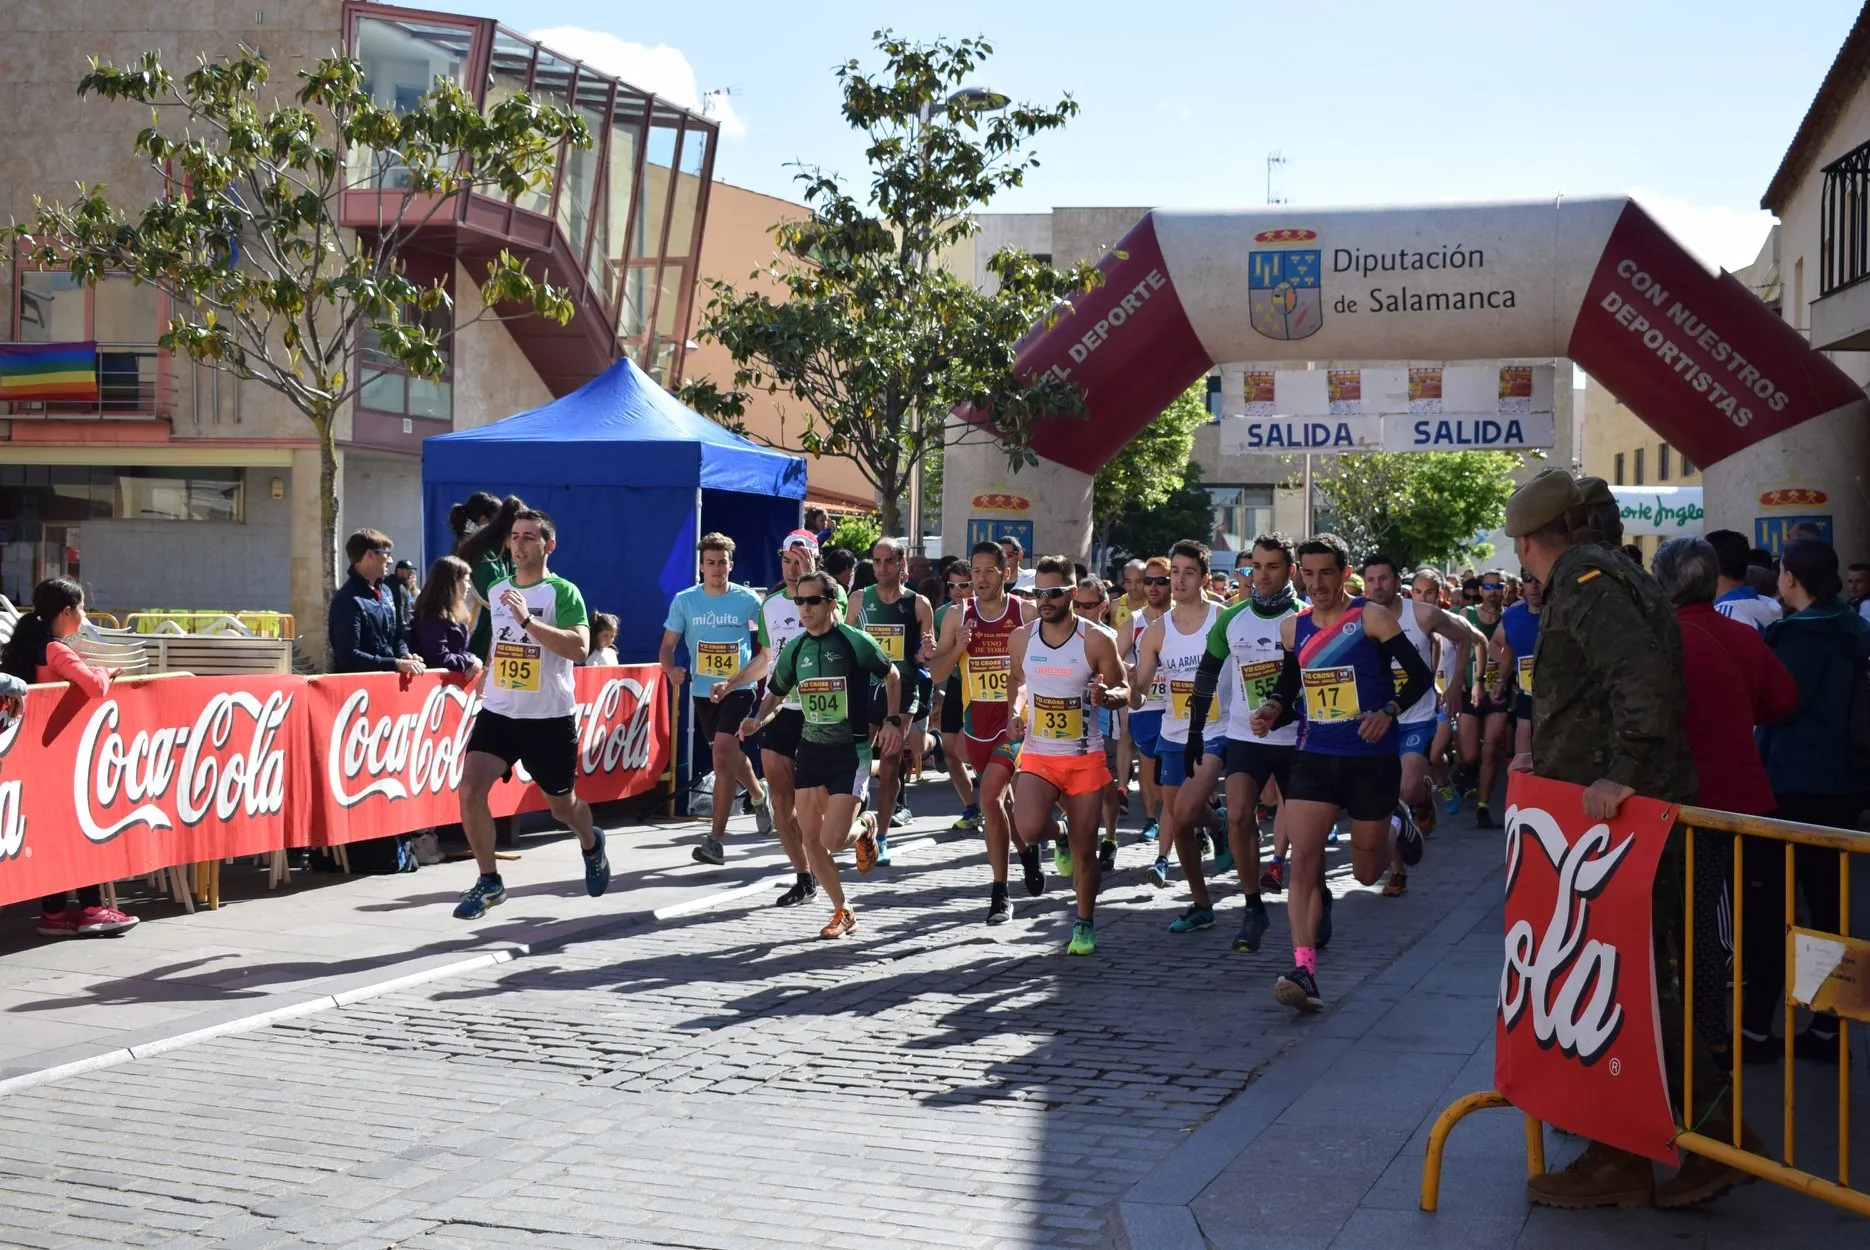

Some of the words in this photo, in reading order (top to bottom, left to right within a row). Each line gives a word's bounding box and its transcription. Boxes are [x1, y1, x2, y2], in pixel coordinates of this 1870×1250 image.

[1333, 243, 1484, 278] Diputación
[1334, 294, 1357, 313] de
[1369, 287, 1516, 313] Salamanca
[1068, 269, 1167, 364] DEPORTE
[1616, 259, 1670, 307] CON
[1666, 302, 1789, 411] NUESTROS
[1600, 291, 1753, 428] DEPORTISTAS
[1247, 423, 1354, 447] SALIDA
[1413, 419, 1525, 444] SALIDA
[1615, 500, 1652, 520] orte
[500, 659, 530, 680] 195
[706, 655, 732, 669] 184
[1166, 658, 1177, 669] LA
[1178, 654, 1202, 668] ARMU
[979, 674, 1007, 690] 109
[809, 694, 838, 711] 504
[1317, 687, 1339, 707] 17
[1045, 712, 1067, 728] 33
[329, 684, 482, 807] Coca-Col
[74, 690, 294, 843] Coca-Cola
